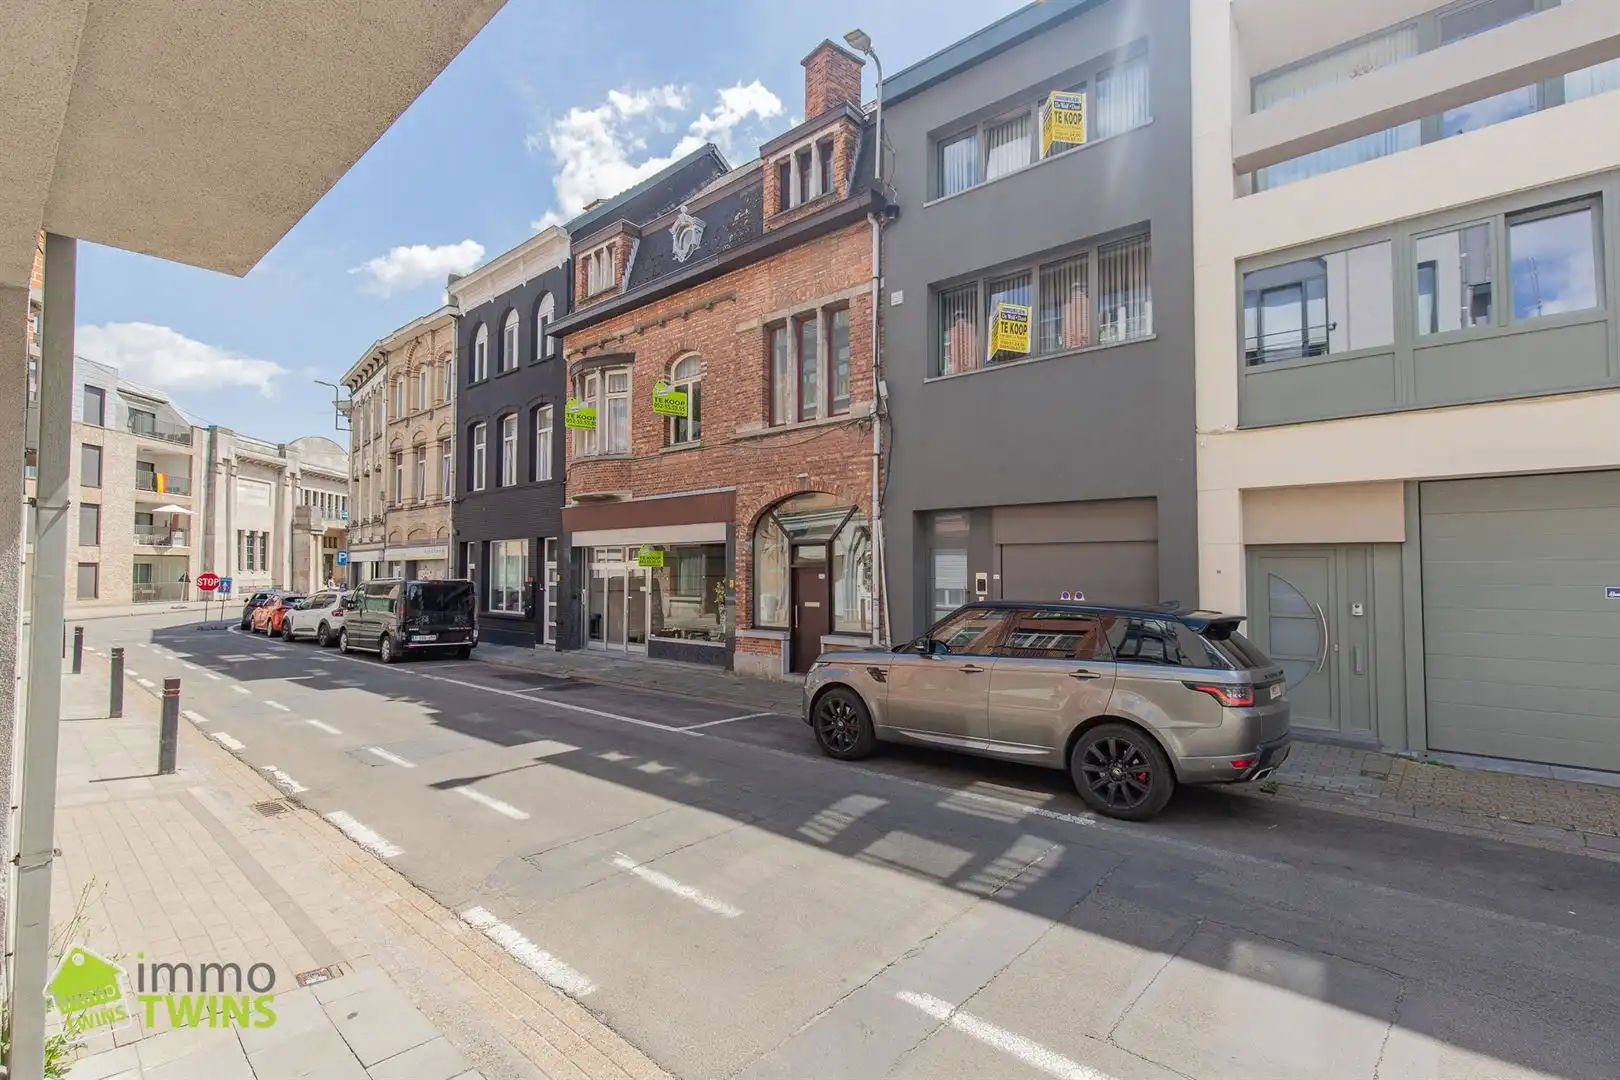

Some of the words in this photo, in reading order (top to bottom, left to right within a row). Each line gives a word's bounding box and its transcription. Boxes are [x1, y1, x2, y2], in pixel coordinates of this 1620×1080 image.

[1053, 110, 1062, 124] TE
[1064, 111, 1083, 125] KOOP
[1000, 320, 1008, 333] TE
[1010, 322, 1028, 335] KOOP
[338, 552, 347, 563] P
[197, 577, 219, 586] STOP
